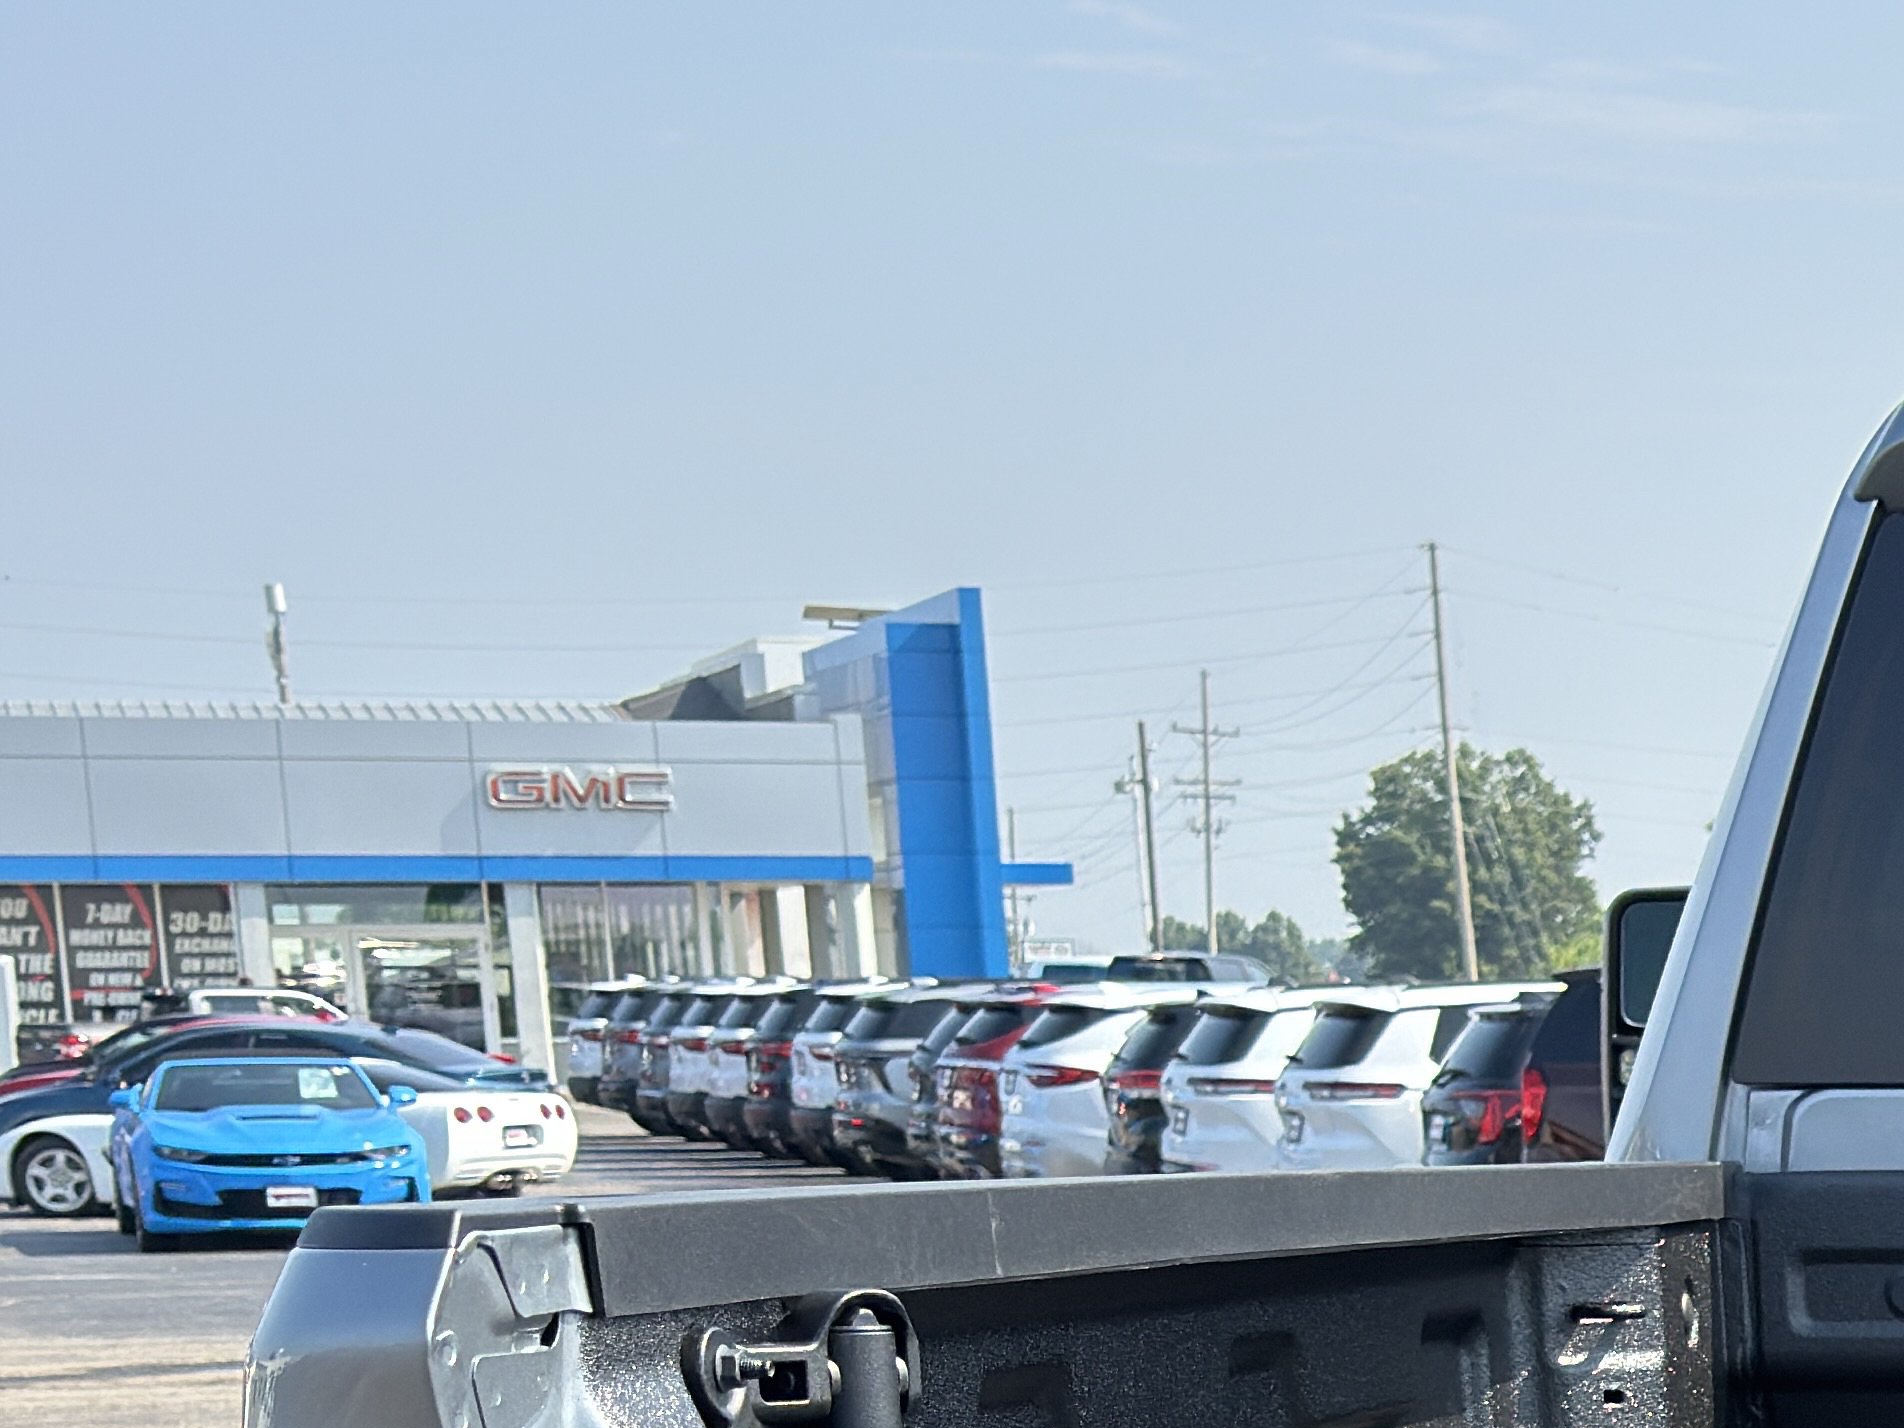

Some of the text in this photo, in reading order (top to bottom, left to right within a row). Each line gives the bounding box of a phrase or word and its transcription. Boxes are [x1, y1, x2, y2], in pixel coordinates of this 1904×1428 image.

[487, 763, 674, 811] GMC
[0, 898, 28, 919] OU
[85, 903, 133, 925] 7-DAY
[169, 911, 232, 934] 30-DA
[18, 953, 54, 975] THE
